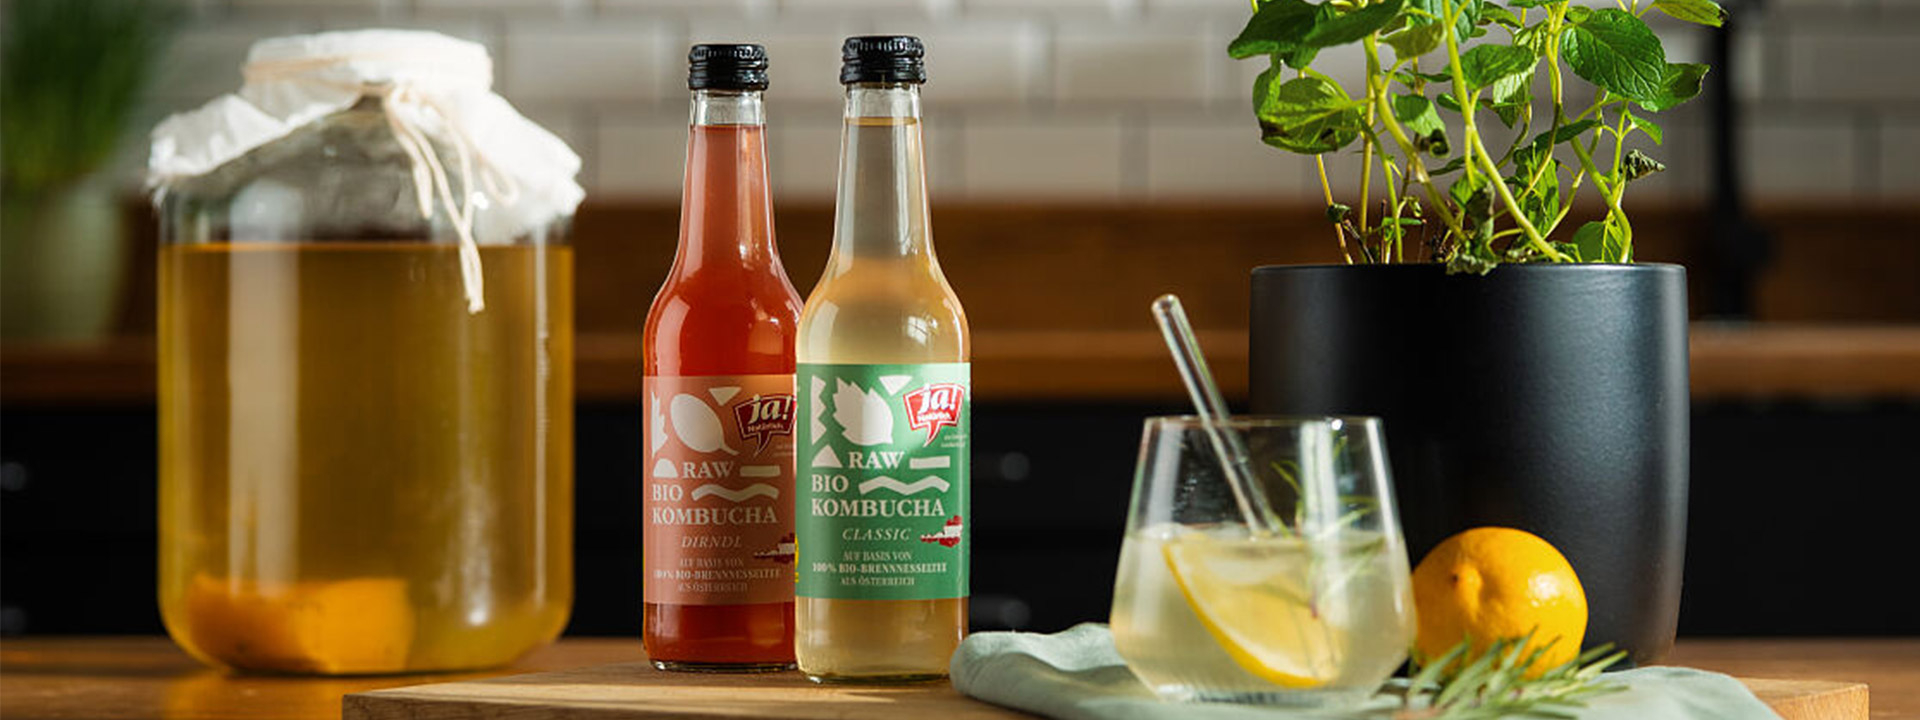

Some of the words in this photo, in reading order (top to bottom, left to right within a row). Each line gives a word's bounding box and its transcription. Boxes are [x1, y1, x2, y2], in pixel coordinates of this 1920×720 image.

[918, 384, 957, 412] ja!
[749, 394, 792, 424] ja!
[848, 450, 905, 469] RAW
[683, 461, 734, 479] RAW
[811, 474, 849, 493] BIO
[652, 484, 684, 502] BIO
[652, 506, 778, 525] KOMBUCHA
[811, 498, 945, 517] KOMBUCHA
[681, 535, 743, 549] DIRNDL
[842, 528, 911, 541] CLASSIC
[863, 551, 891, 561] BASIS
[893, 551, 912, 561] VON
[812, 562, 837, 573] 100%
